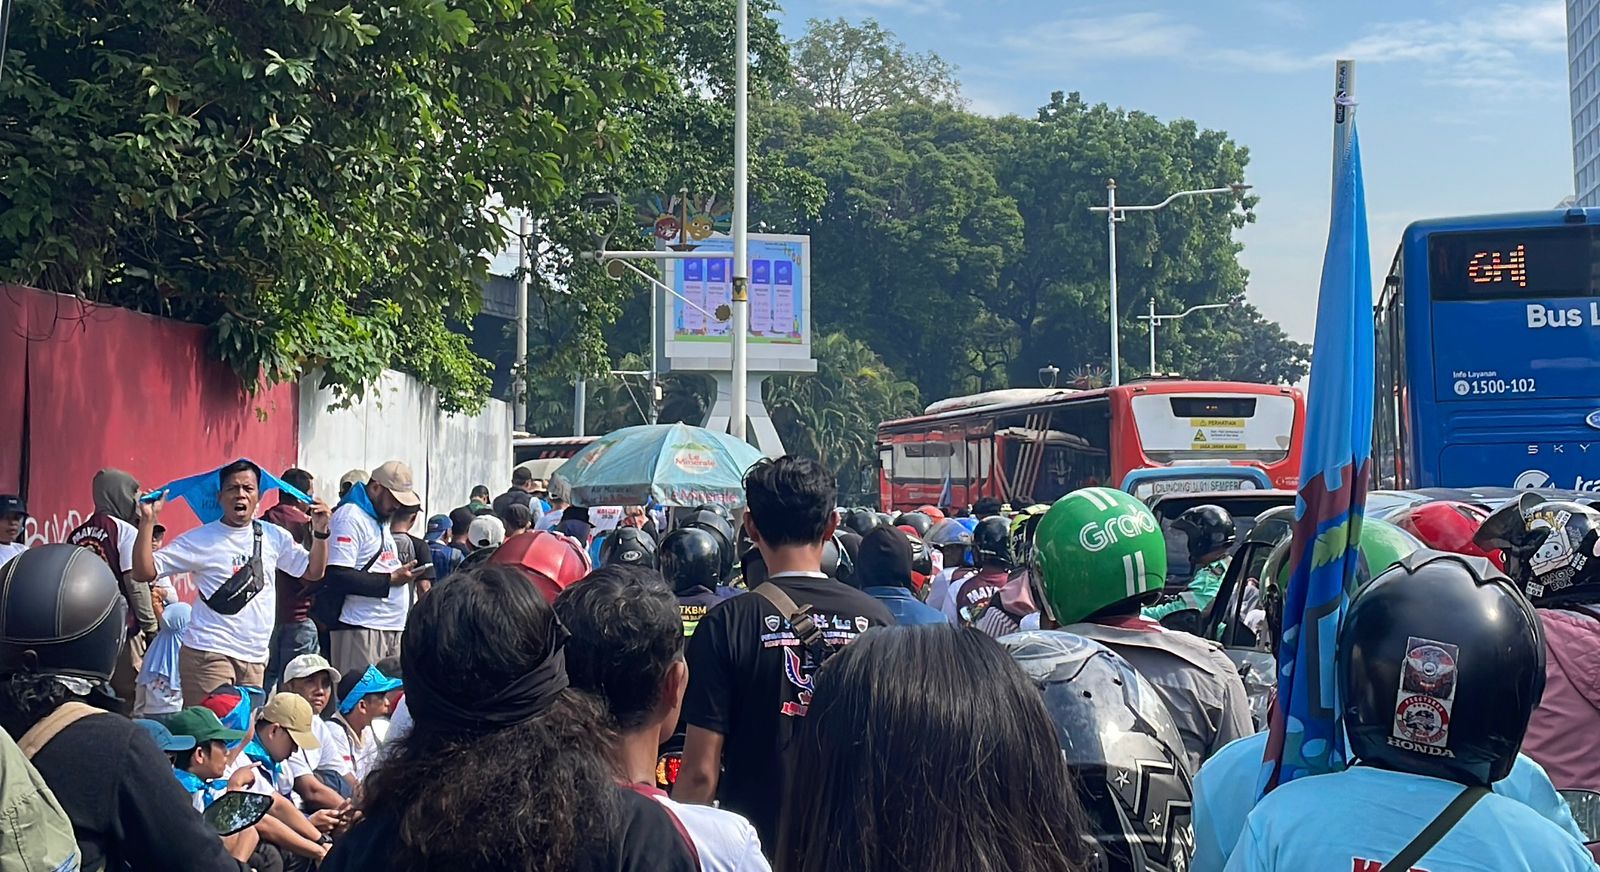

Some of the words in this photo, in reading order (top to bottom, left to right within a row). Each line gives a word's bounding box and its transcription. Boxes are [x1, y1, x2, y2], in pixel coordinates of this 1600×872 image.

[1527, 304, 1582, 328] Bus
[1468, 370, 1497, 379] Layanan
[1472, 379, 1536, 394] 1500-102
[1079, 503, 1155, 552] Grab
[1386, 735, 1456, 758] HONDA
